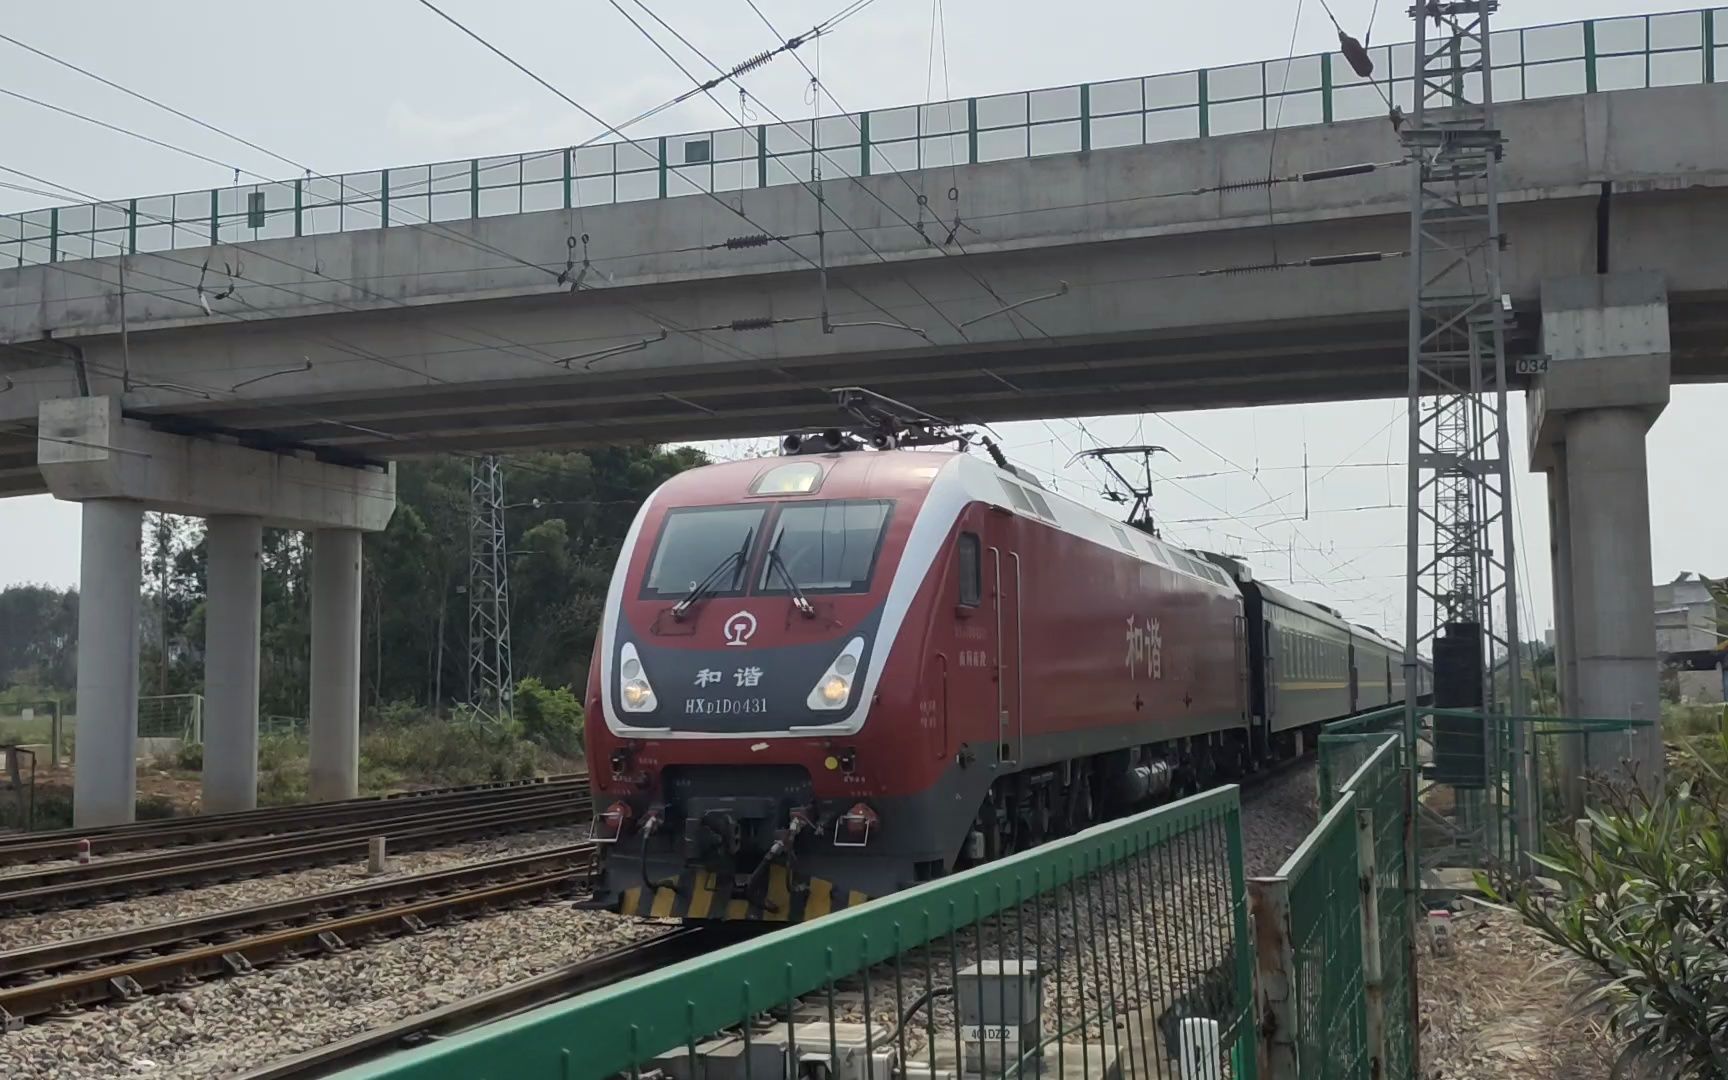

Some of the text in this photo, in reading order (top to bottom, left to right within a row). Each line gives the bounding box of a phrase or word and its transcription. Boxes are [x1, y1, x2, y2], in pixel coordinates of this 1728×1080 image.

[1518, 359, 1548, 373] 034
[1125, 612, 1162, 681] 和谐
[693, 666, 764, 688] 和谐
